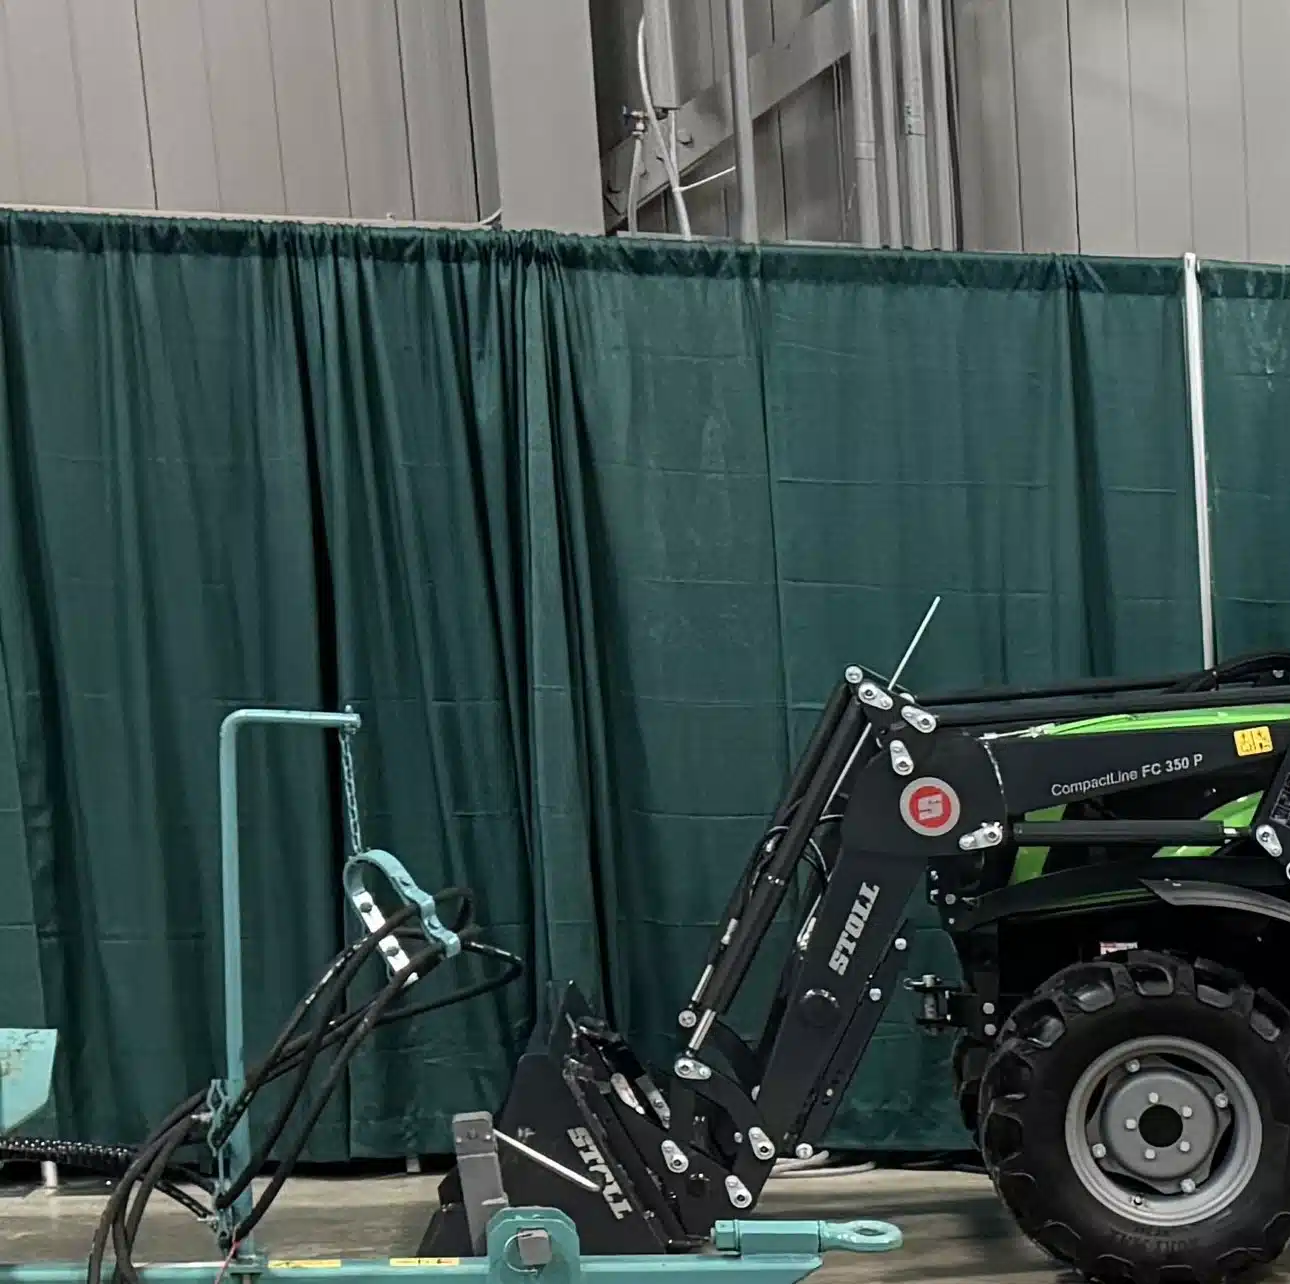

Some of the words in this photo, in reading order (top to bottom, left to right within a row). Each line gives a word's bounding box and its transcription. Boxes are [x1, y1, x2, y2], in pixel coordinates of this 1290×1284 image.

[1051, 770, 1138, 797] CompactLine
[1142, 763, 1162, 778] FC
[1165, 757, 1190, 773] 350
[1193, 753, 1203, 767] P
[828, 881, 881, 976] STOLL
